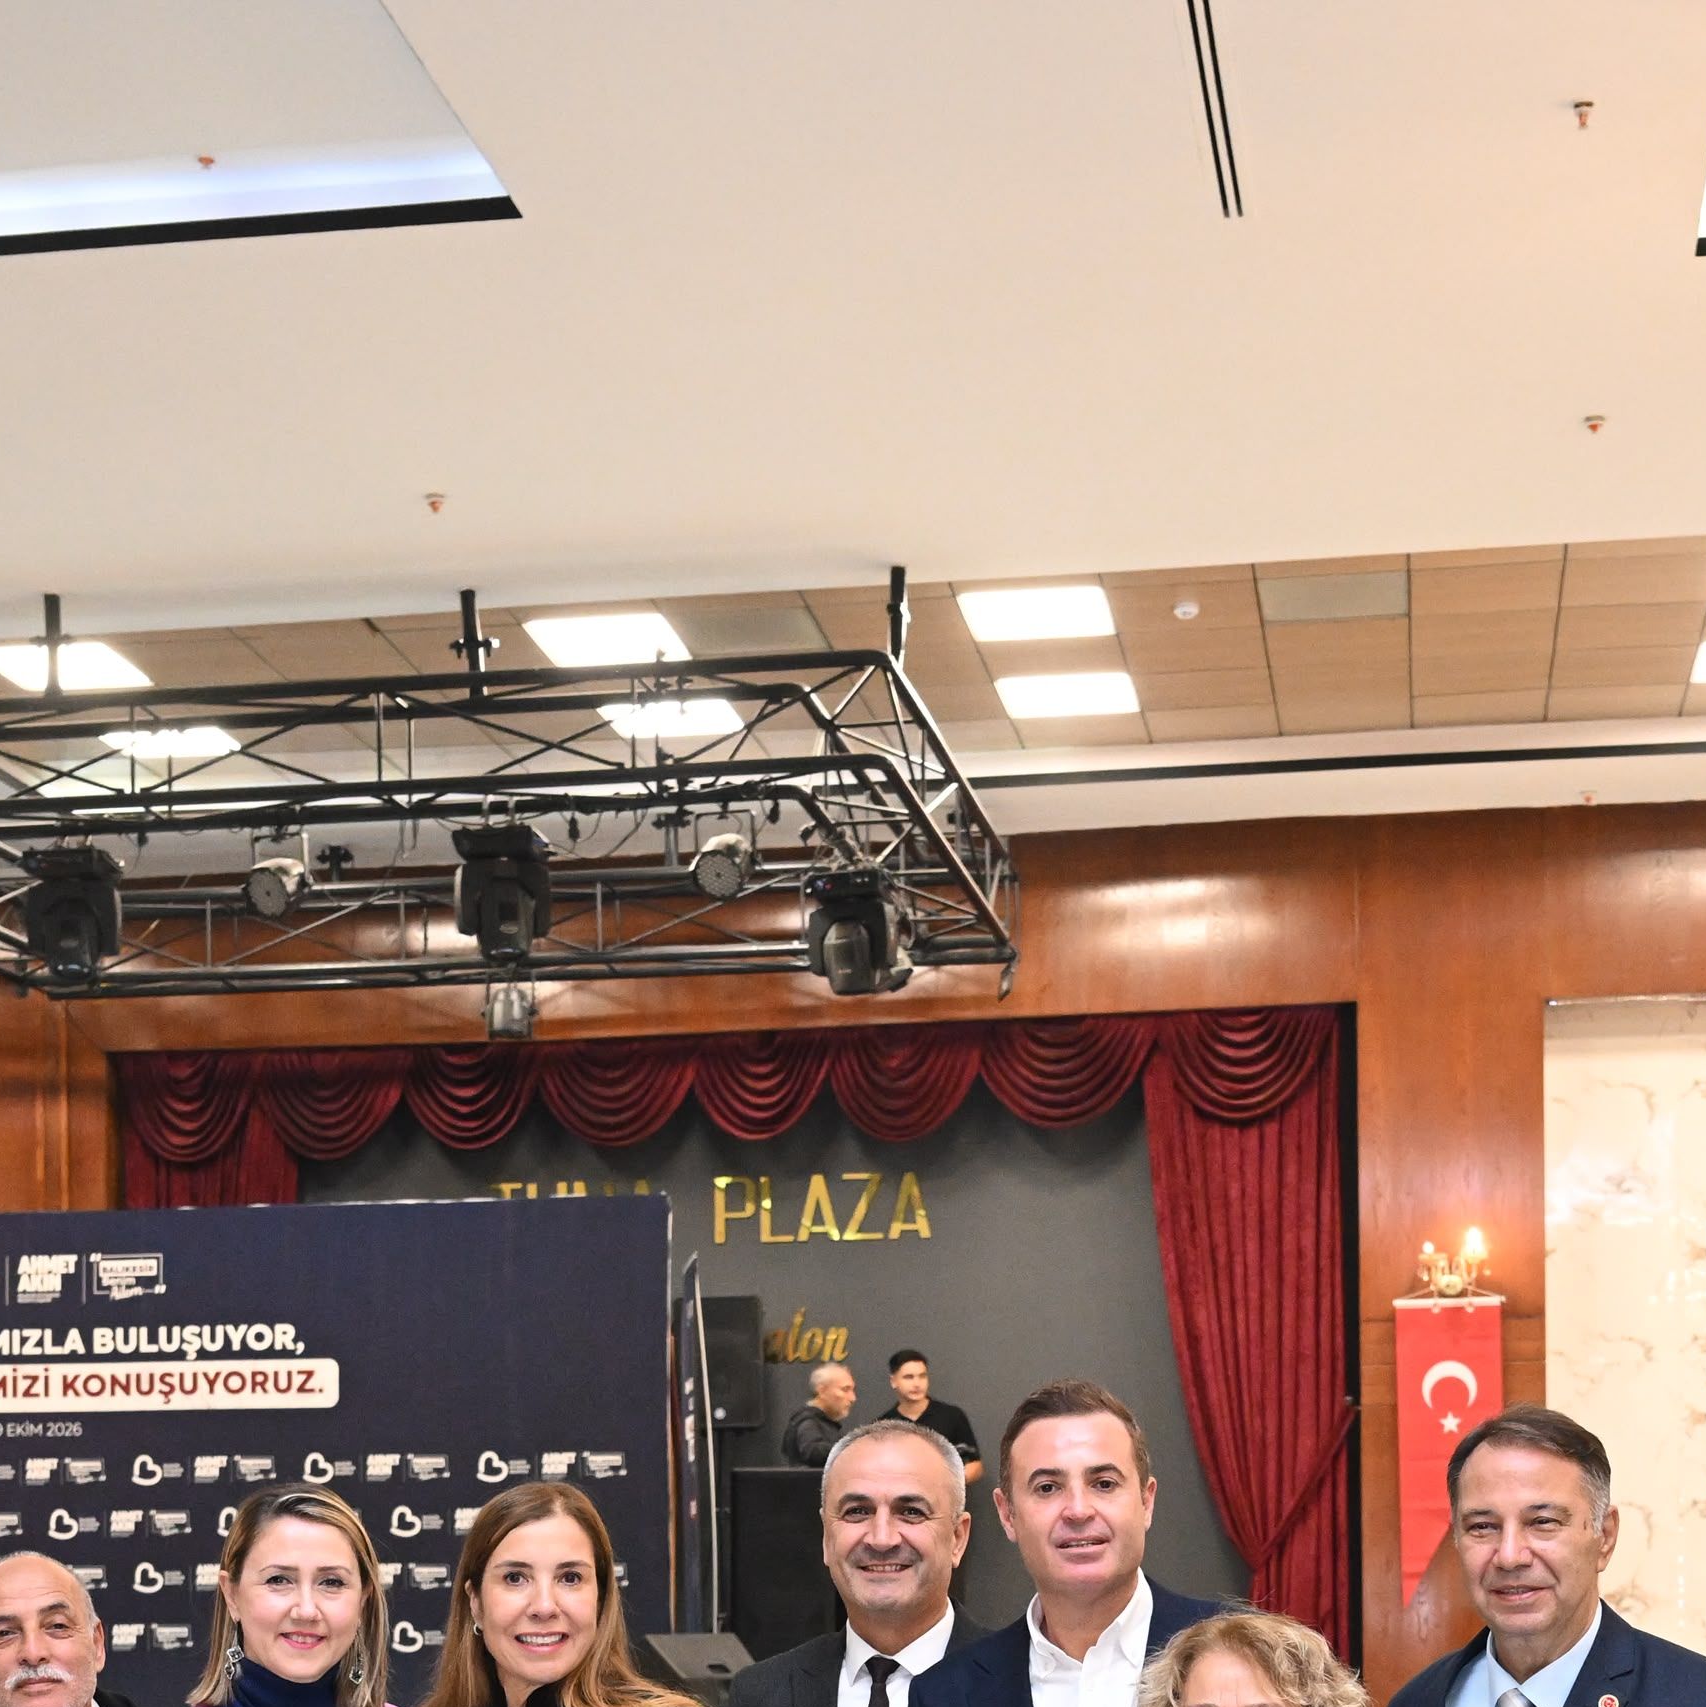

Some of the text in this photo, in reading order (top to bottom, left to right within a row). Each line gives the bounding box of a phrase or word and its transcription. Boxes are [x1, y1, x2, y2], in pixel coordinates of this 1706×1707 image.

[713, 1171, 933, 1245] PLAZA
[92, 1322, 306, 1361] BULUŞUYOR,
[61, 1369, 325, 1405] KONUŞUYORUZ.
[6, 1419, 44, 1438] EKİM
[45, 1421, 83, 1438] 2026
